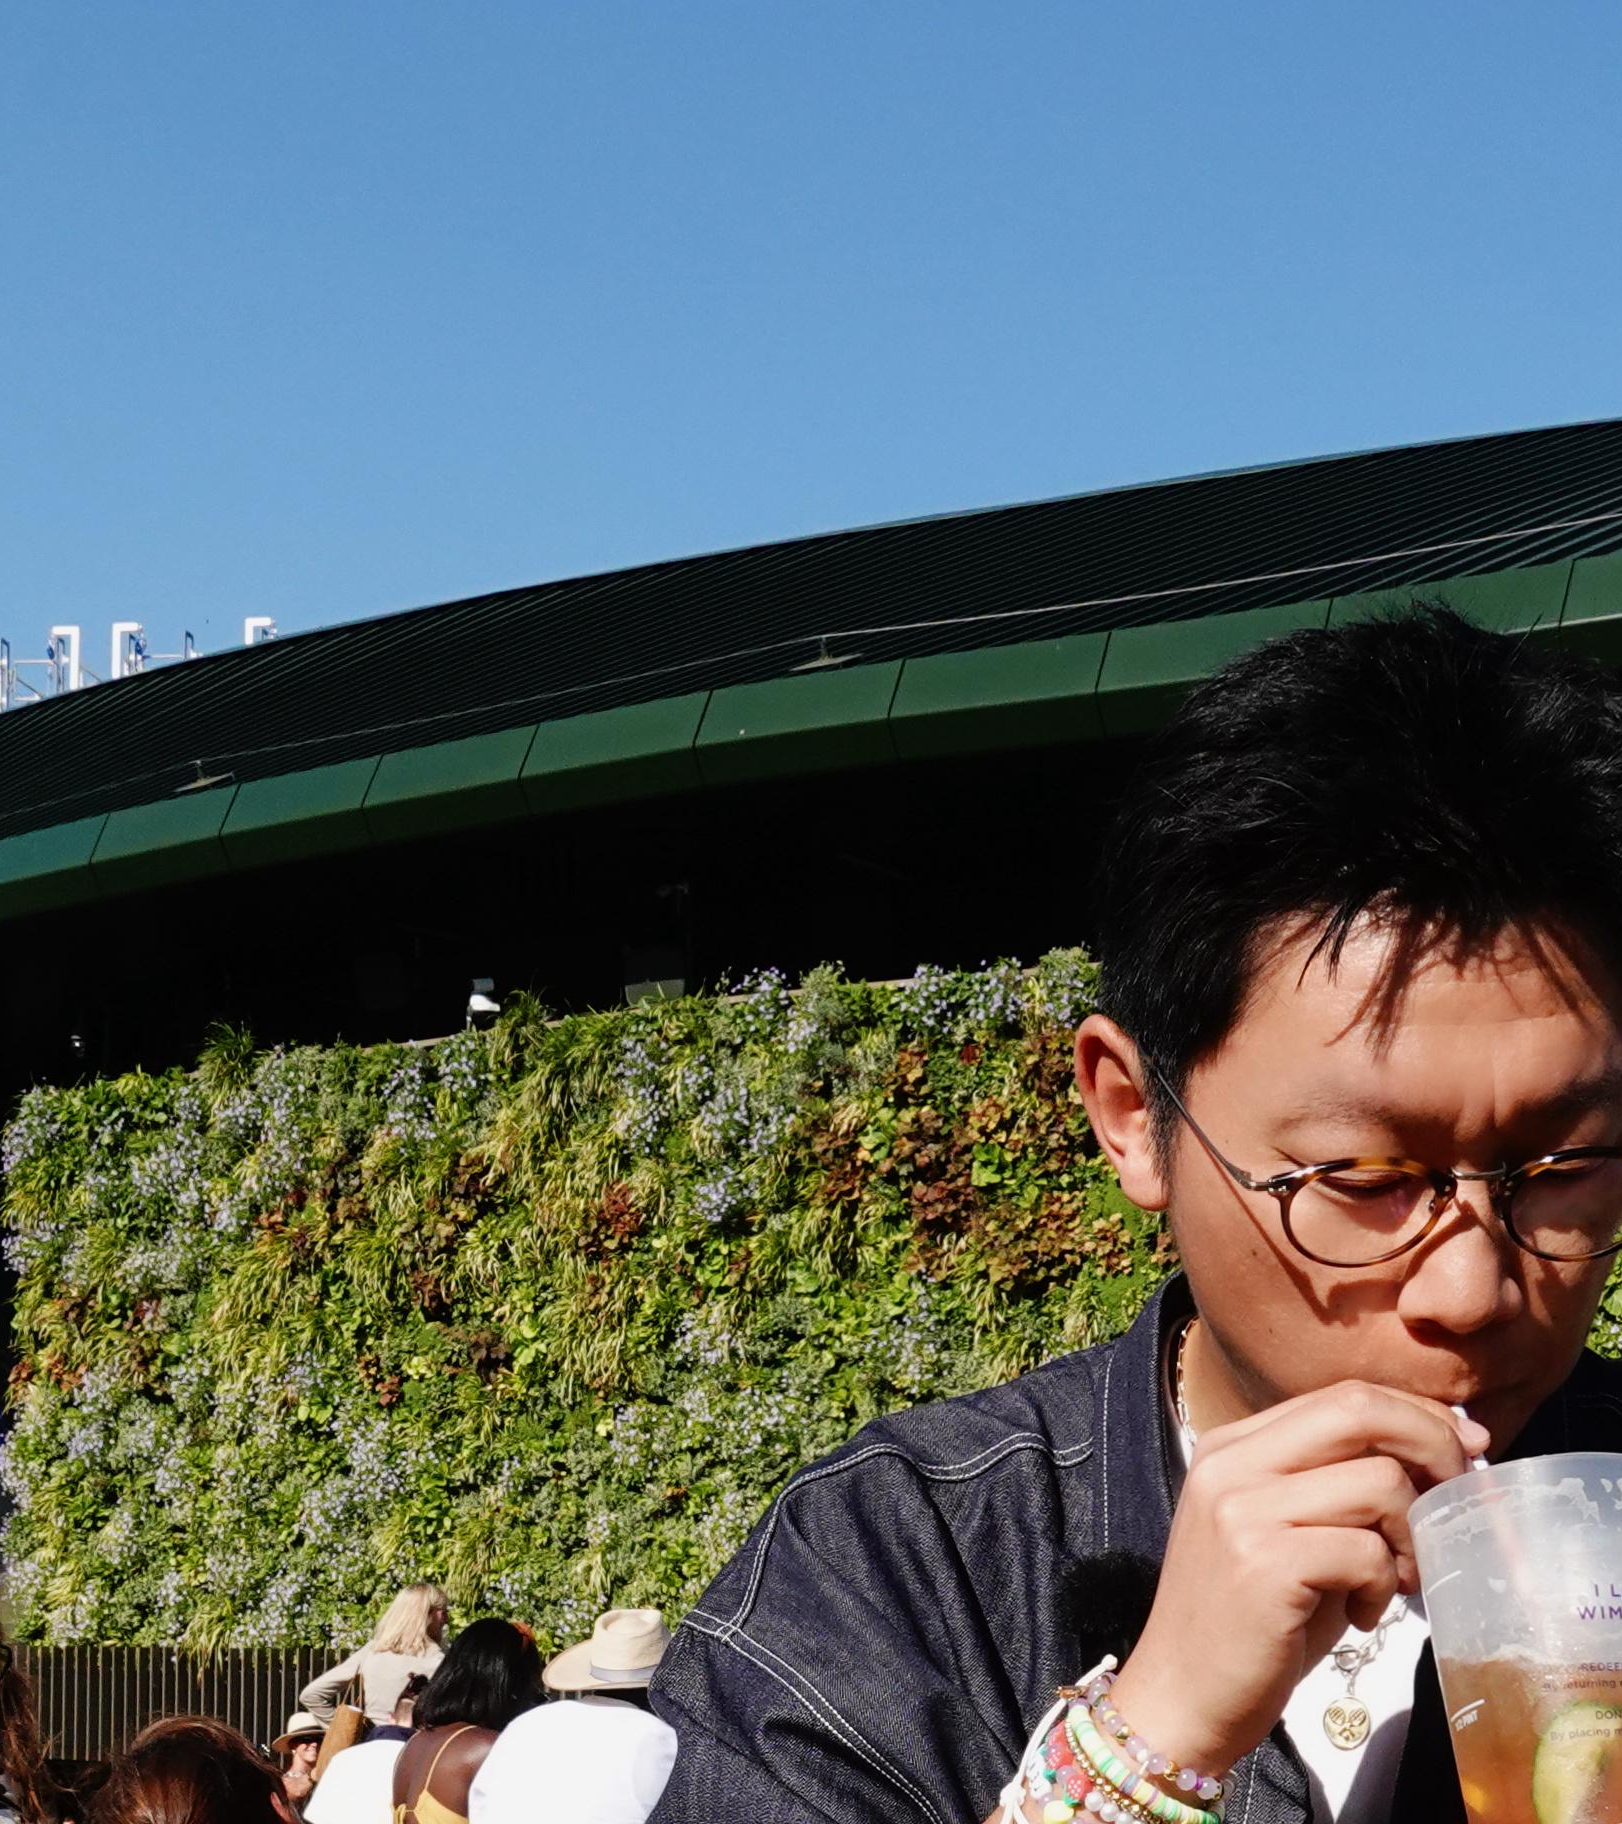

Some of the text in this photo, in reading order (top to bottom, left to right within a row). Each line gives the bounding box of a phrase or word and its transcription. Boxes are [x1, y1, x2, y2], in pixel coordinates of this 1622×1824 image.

[1594, 1583, 1600, 1598] I
[1550, 1730, 1565, 1742] By
[1569, 1728, 1611, 1740] placing
